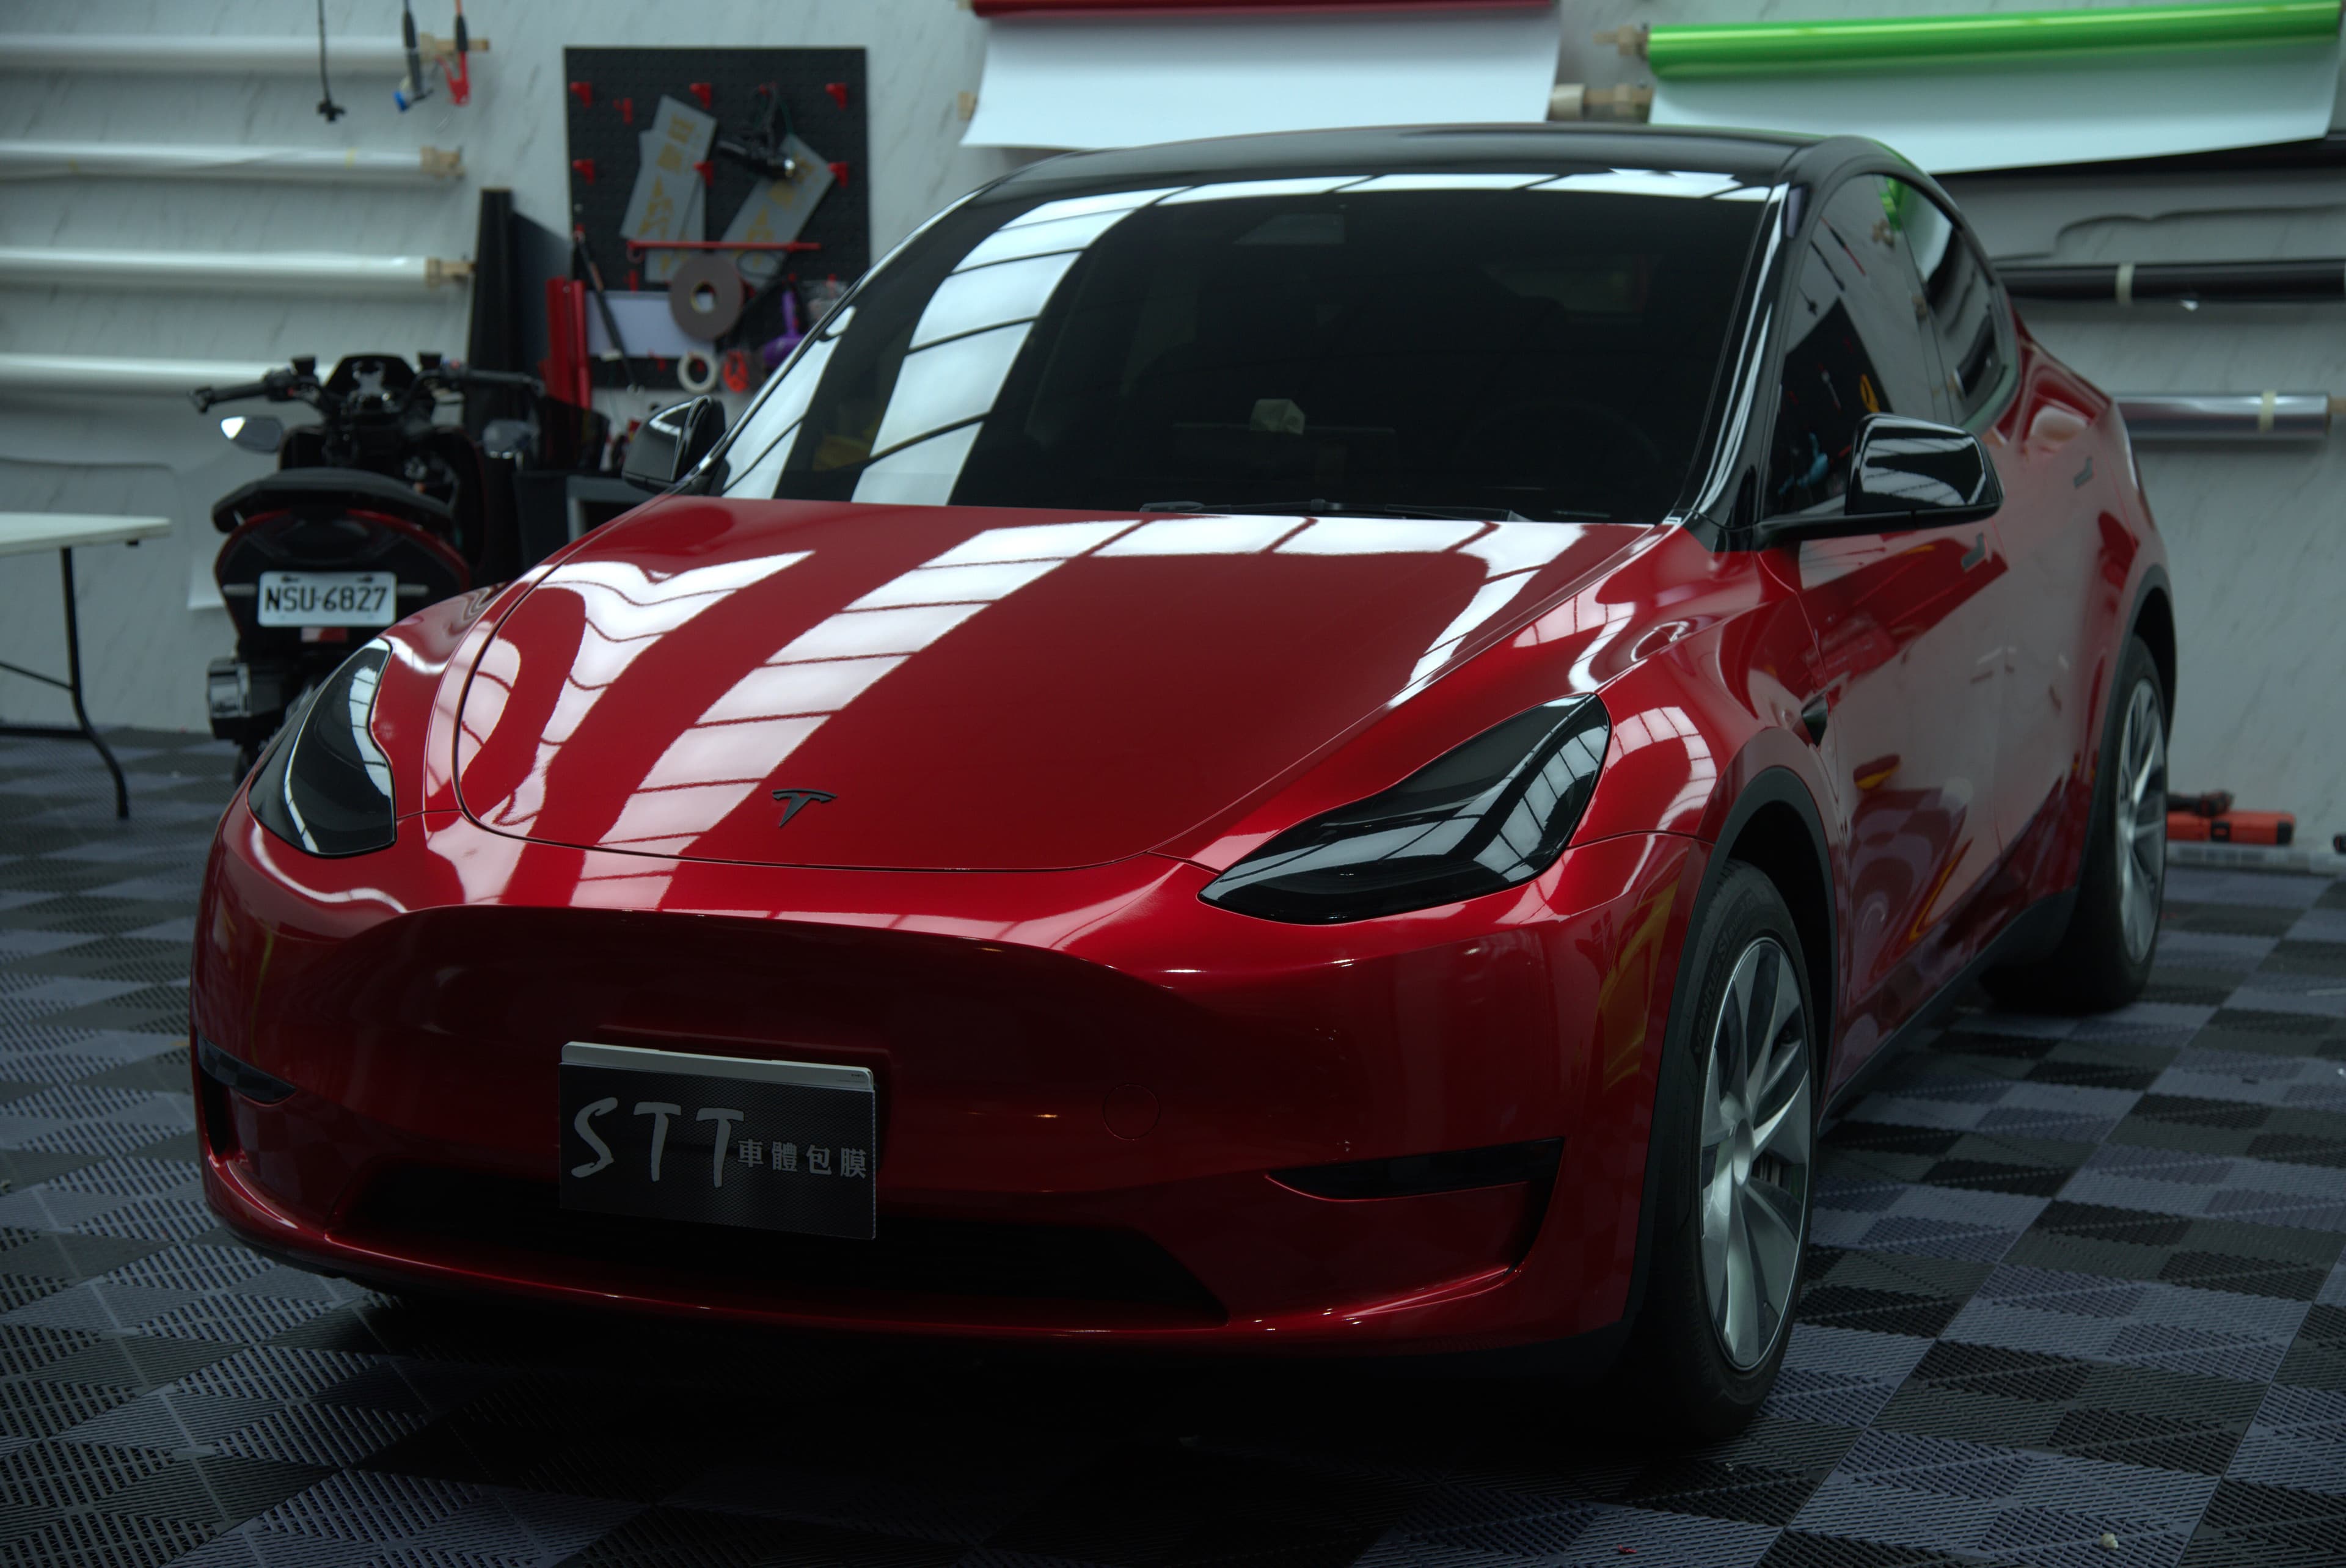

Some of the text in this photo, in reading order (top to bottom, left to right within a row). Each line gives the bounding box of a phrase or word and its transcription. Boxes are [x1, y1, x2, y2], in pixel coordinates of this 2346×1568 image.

[265, 586, 387, 612] NSU-6827
[571, 1096, 744, 1188] STT
[738, 1139, 867, 1178] 車體包膜
